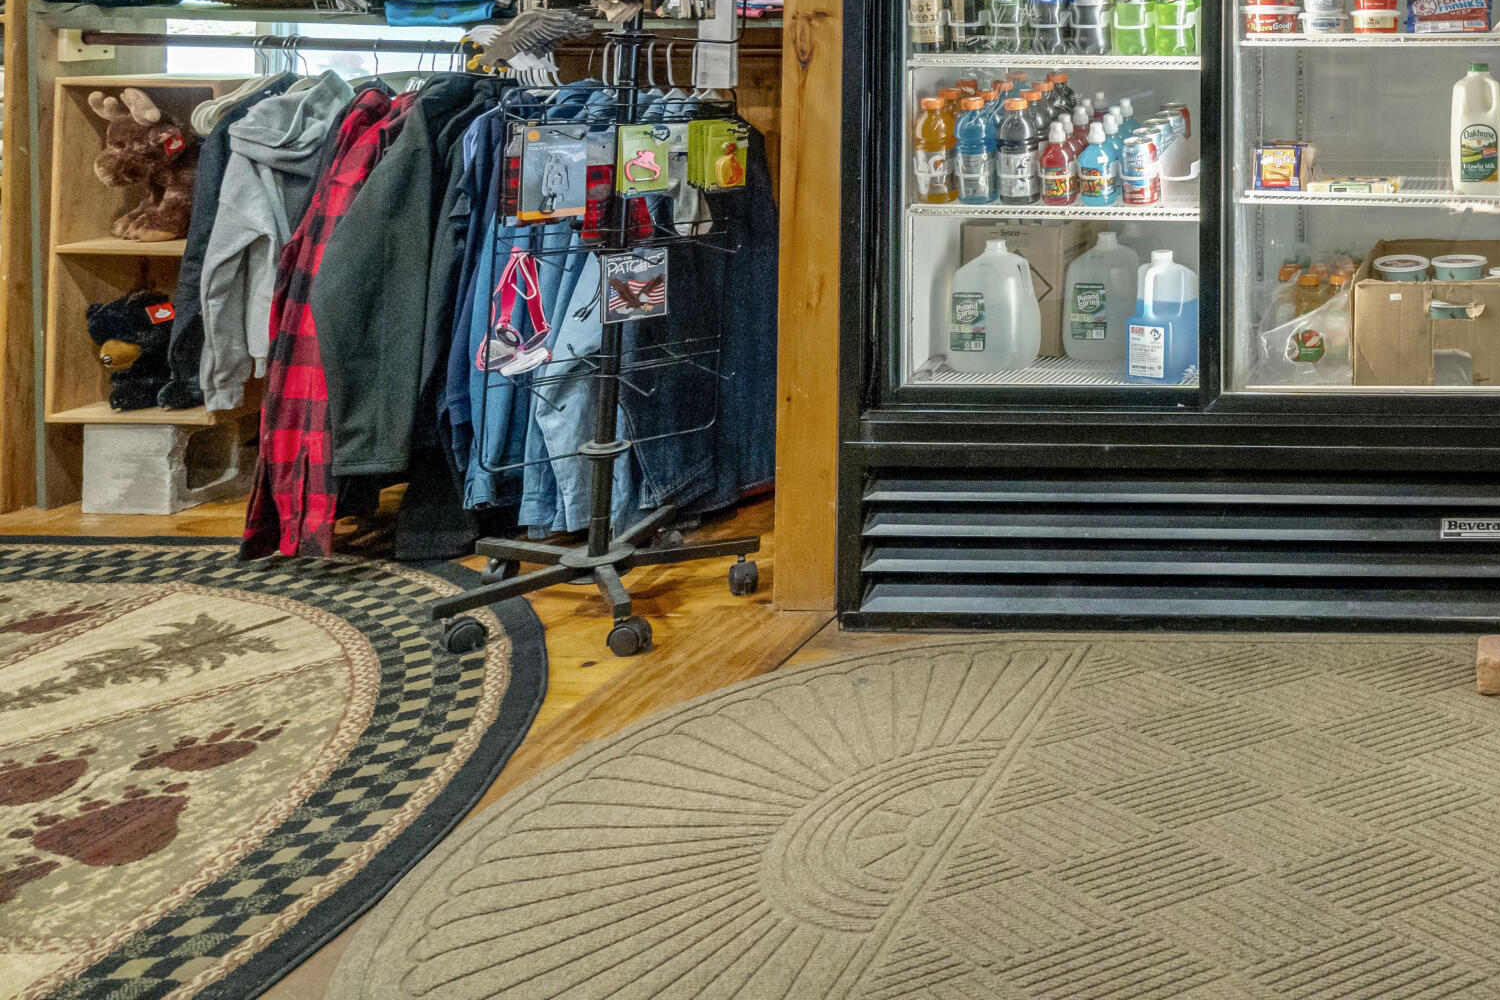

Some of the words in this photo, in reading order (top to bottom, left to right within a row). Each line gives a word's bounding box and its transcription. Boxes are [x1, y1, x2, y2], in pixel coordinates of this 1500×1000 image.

[1464, 129, 1495, 139] Oakhurst
[1000, 229, 1020, 238] Sysco
[1077, 292, 1099, 302] Poland
[956, 302, 978, 312] Poland
[1077, 299, 1100, 312] Spring
[956, 308, 979, 321] Spring
